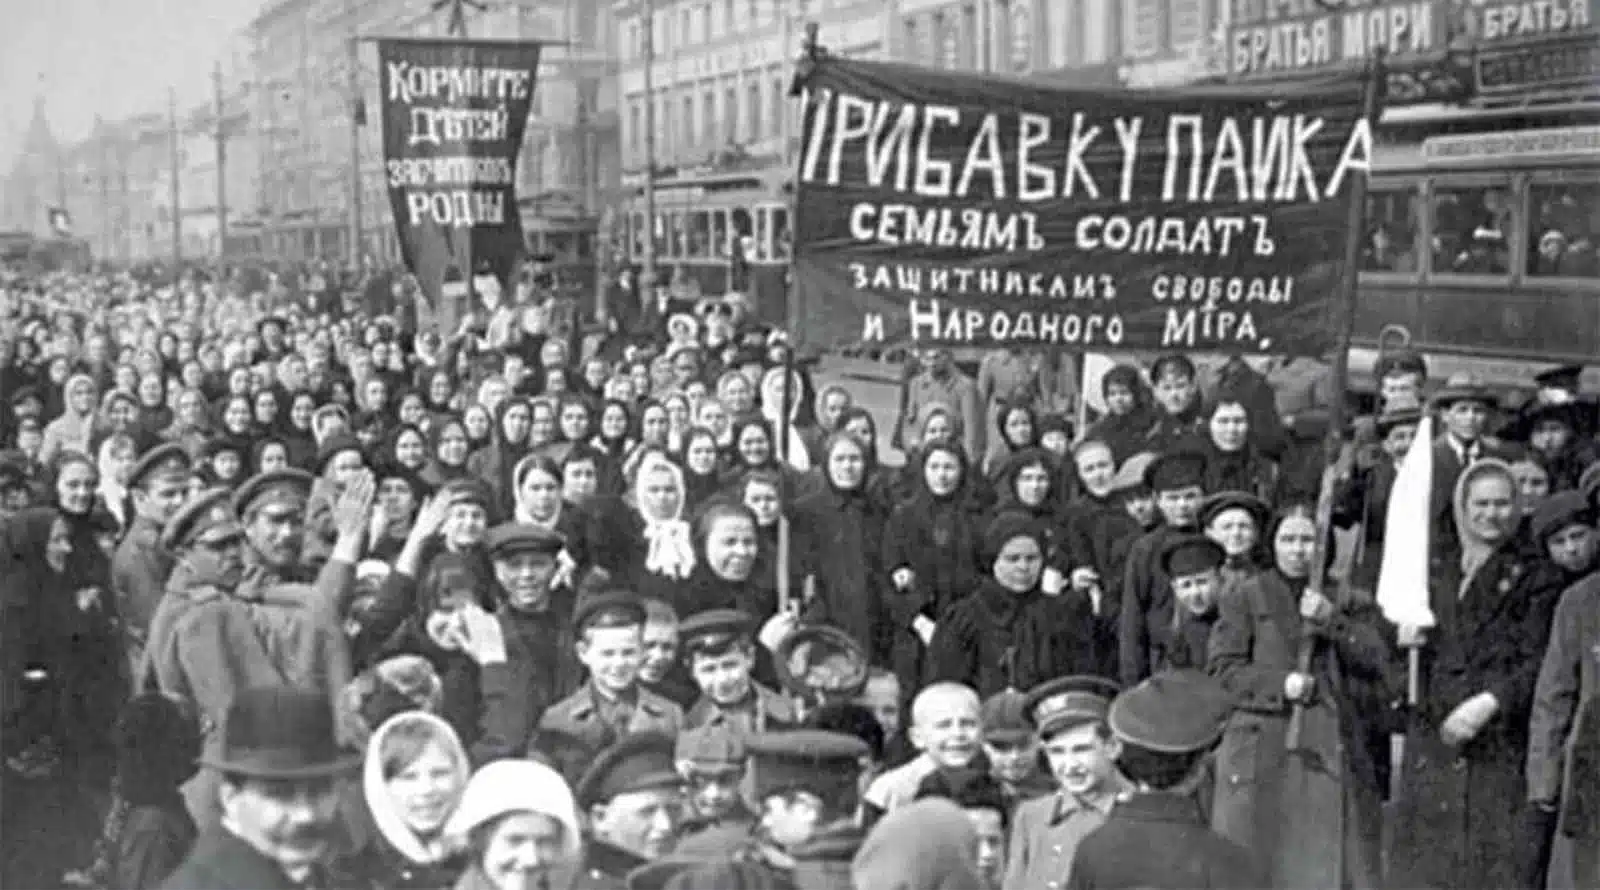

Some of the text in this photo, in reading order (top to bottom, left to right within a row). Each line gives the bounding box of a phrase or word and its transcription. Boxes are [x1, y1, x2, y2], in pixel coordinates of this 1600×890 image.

[1484, 0, 1589, 39] БРАТЬЯ
[1233, 17, 1331, 74] БРАТЬЯ
[850, 202, 1275, 257] СЕМЬЯМЪ СОЛДАТЪ
[850, 263, 1294, 304] ЗАЩИТНИКАМЪ СВОБОДЫ
[909, 299, 1124, 345] НАРОДНОГО
